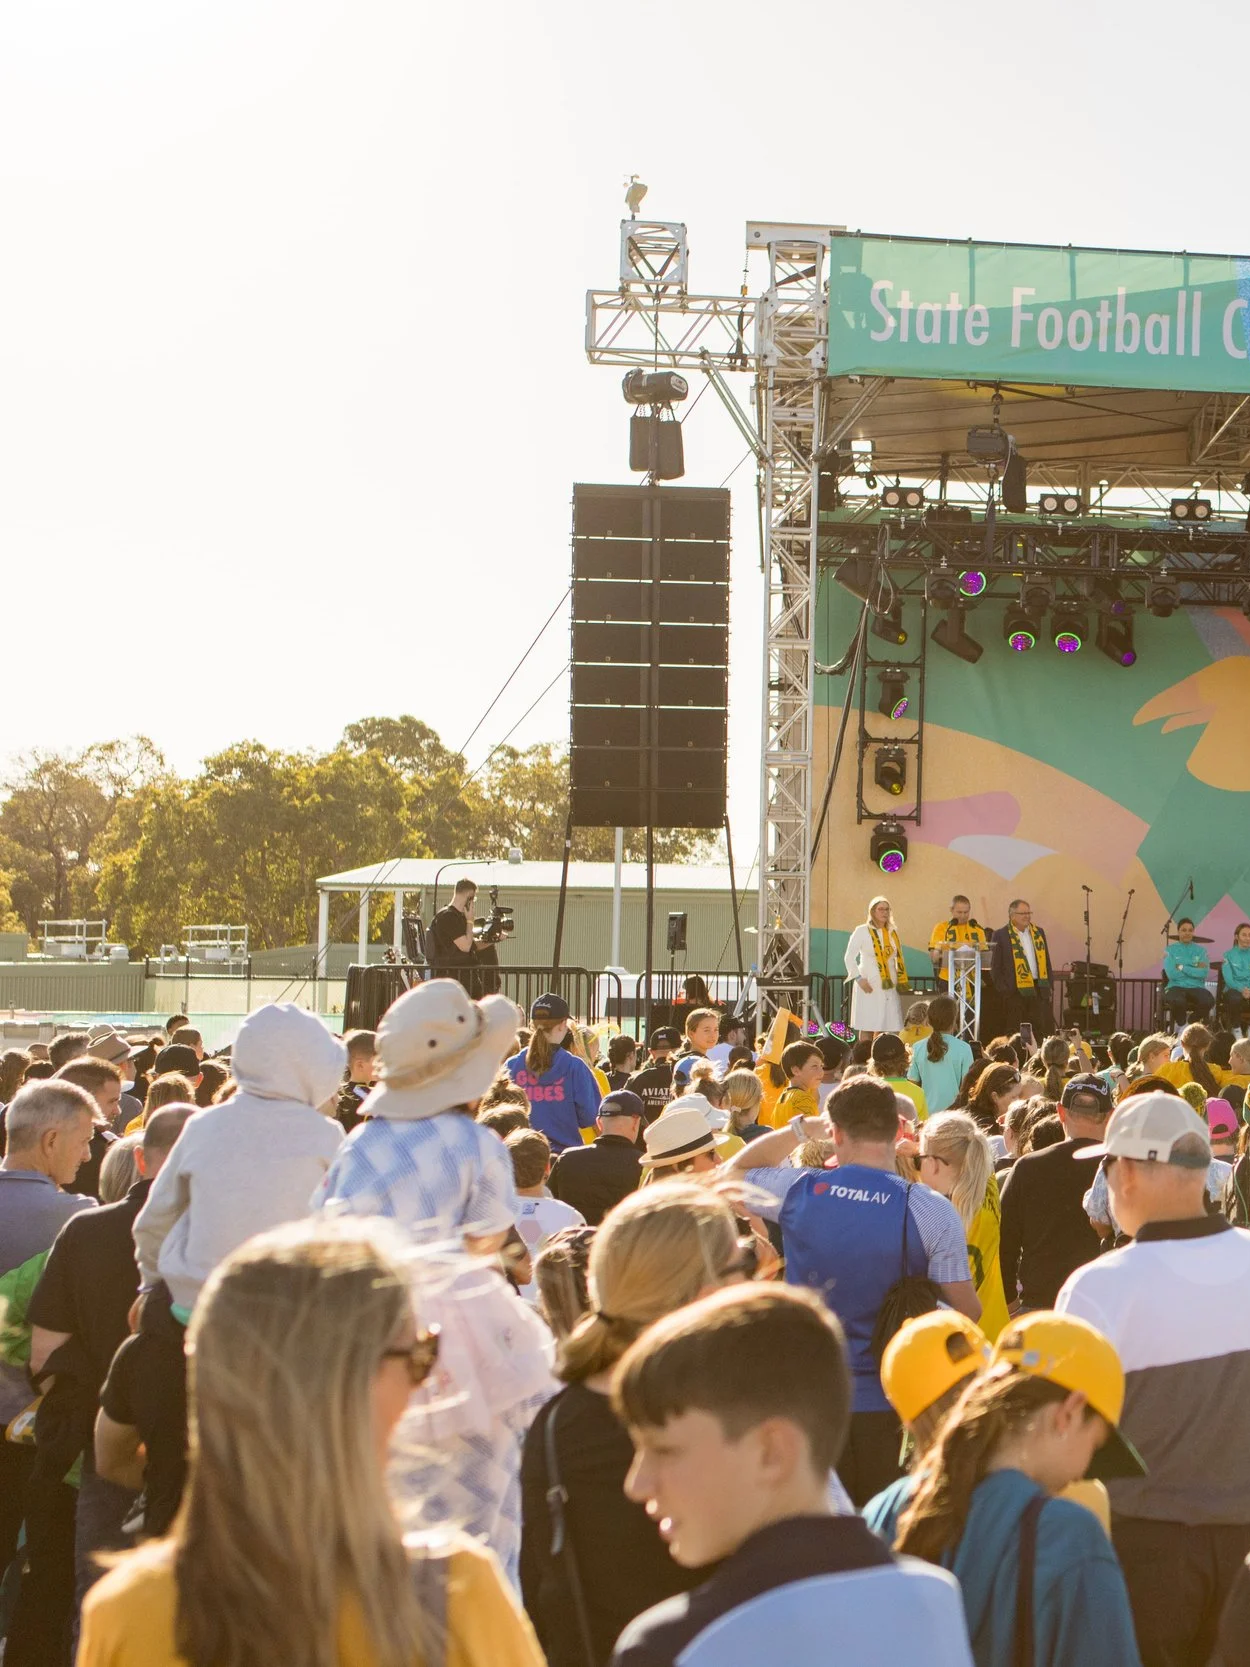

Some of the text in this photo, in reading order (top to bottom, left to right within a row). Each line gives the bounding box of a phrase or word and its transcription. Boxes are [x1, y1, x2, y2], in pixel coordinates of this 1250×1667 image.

[870, 279, 990, 347] State
[1011, 286, 1202, 357] Football
[525, 1085, 565, 1102] IBES
[641, 1087, 670, 1097] AVIAT
